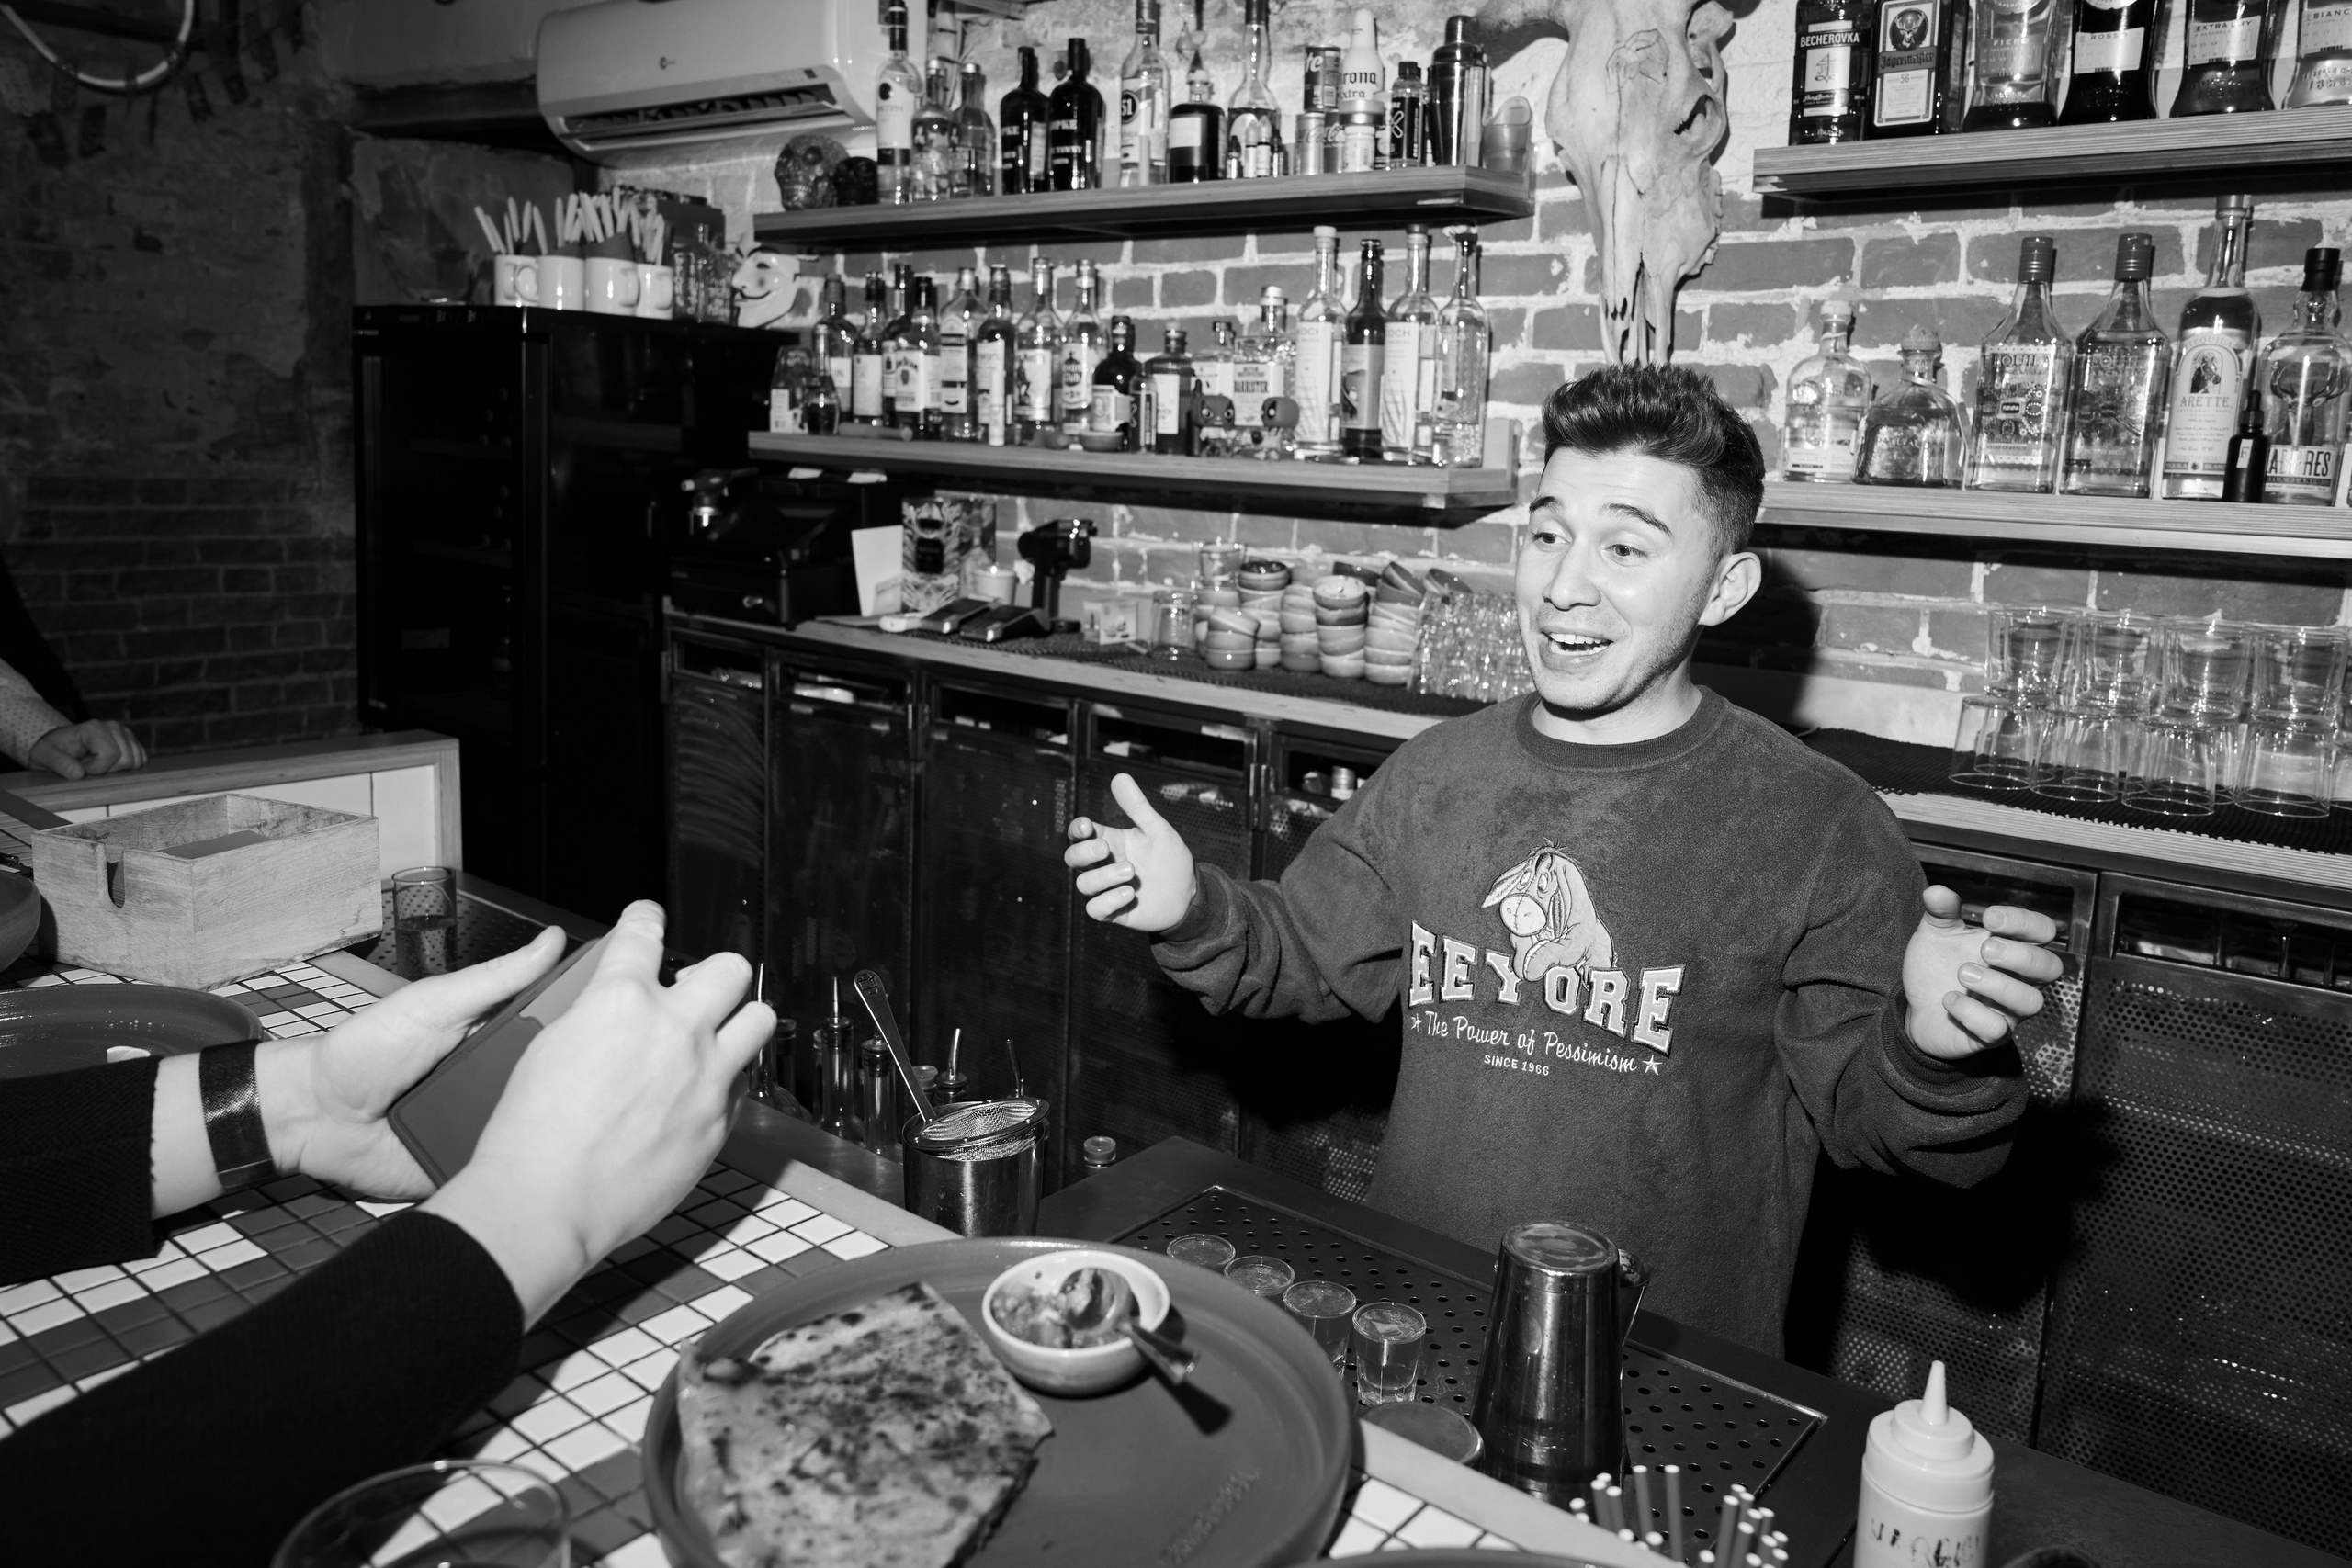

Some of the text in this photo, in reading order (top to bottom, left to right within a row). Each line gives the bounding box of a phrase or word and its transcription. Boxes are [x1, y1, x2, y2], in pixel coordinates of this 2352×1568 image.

[2313, 8, 2350, 19] BIANC
[2197, 23, 2227, 32] EXTRA
[1800, 32, 1860, 47] BECHEROVKA
[1993, 38, 2029, 46] FIERO
[1343, 72, 1376, 84] rona
[1900, 73, 1910, 84] 56
[2188, 334, 2233, 348] TEQUILA
[2180, 396, 2230, 408] ARETTE
[2240, 446, 2250, 458] F
[2266, 449, 2331, 477] ADORES
[1408, 920, 1686, 1056] EEYORE
[1425, 1010, 1637, 1073] The Power of Pessimism
[1484, 1055, 1549, 1076] SINCE 1966
